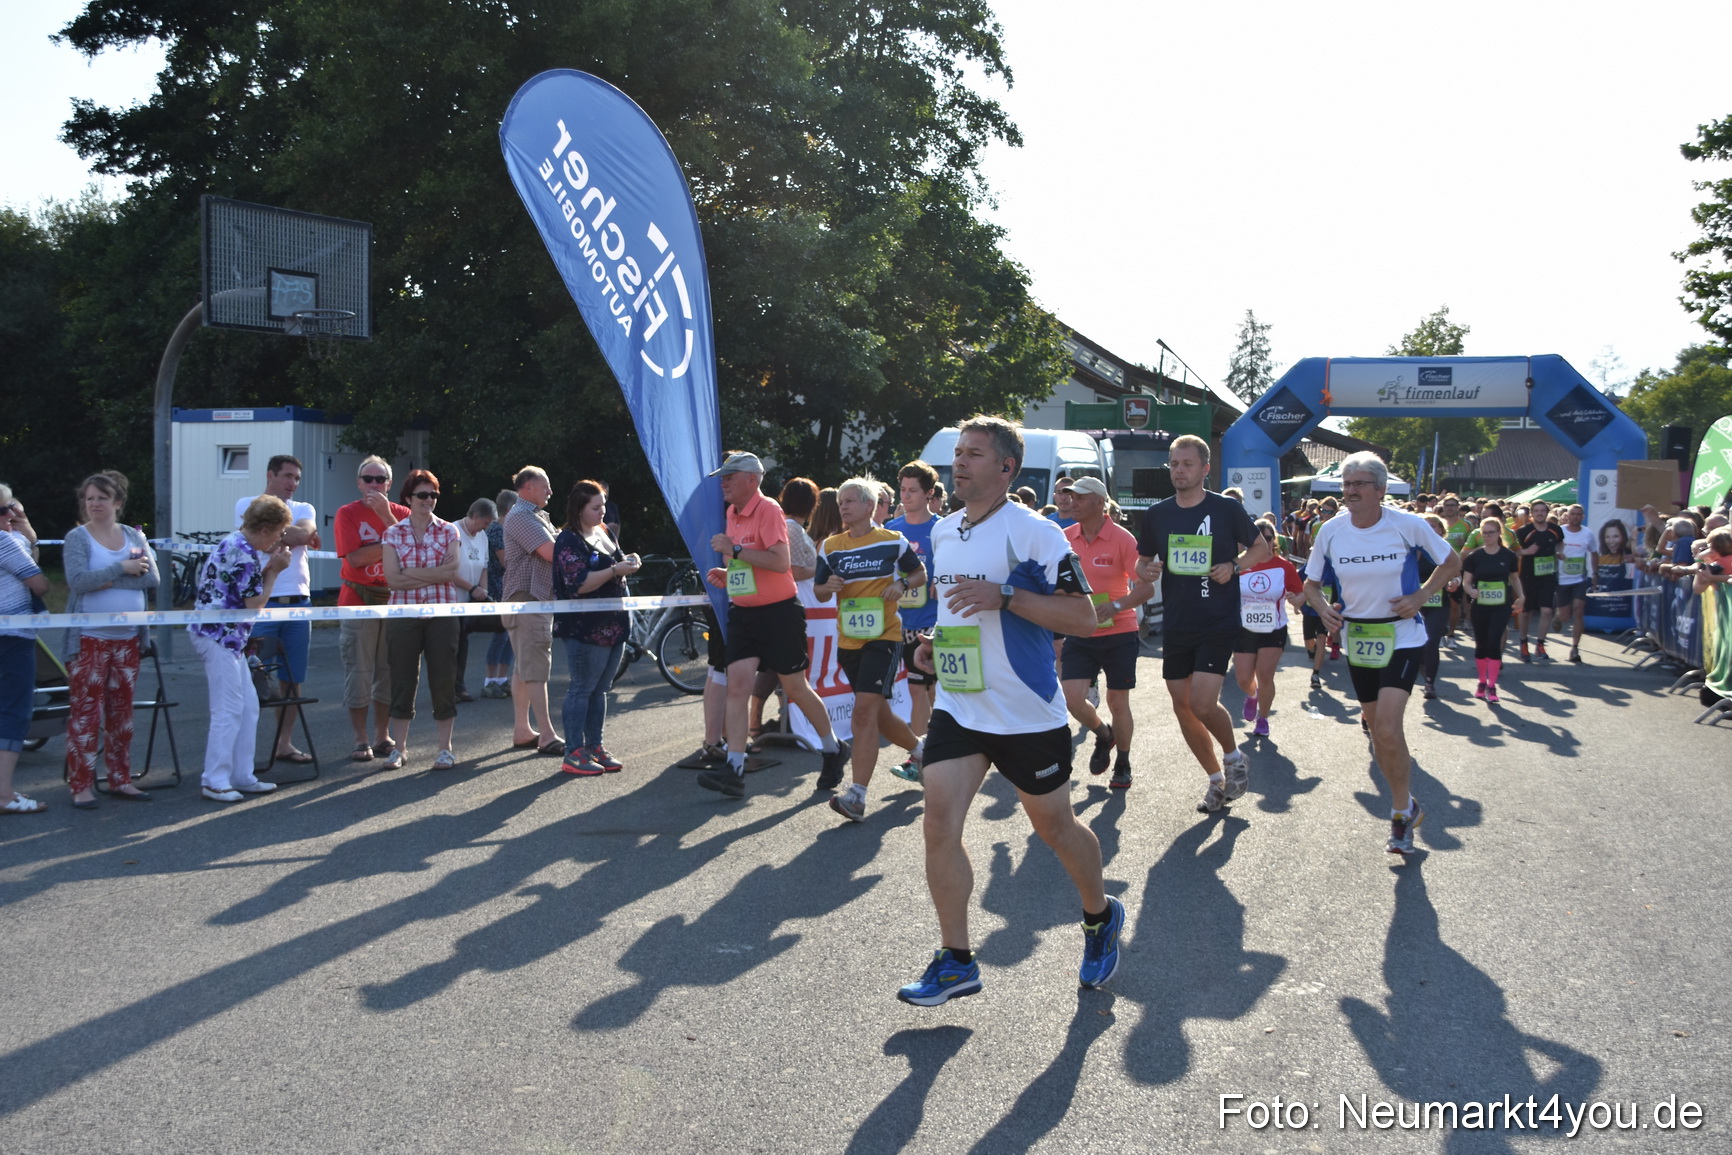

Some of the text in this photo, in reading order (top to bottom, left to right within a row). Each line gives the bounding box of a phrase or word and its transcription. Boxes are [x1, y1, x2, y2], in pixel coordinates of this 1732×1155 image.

[1406, 386, 1481, 399] firmenlauf
[1266, 411, 1306, 420] Fischer
[1693, 466, 1723, 495] AOK
[1173, 551, 1207, 564] 1148
[1340, 553, 1397, 564] DELPHI
[844, 559, 884, 570] Fischer
[848, 566, 881, 574] AUTOMOBILE
[729, 572, 746, 586] 457
[1480, 591, 1503, 599] 1550
[849, 614, 875, 628] 419
[1246, 613, 1273, 624] 8925
[1356, 641, 1386, 656] 279
[940, 652, 968, 675] 281
